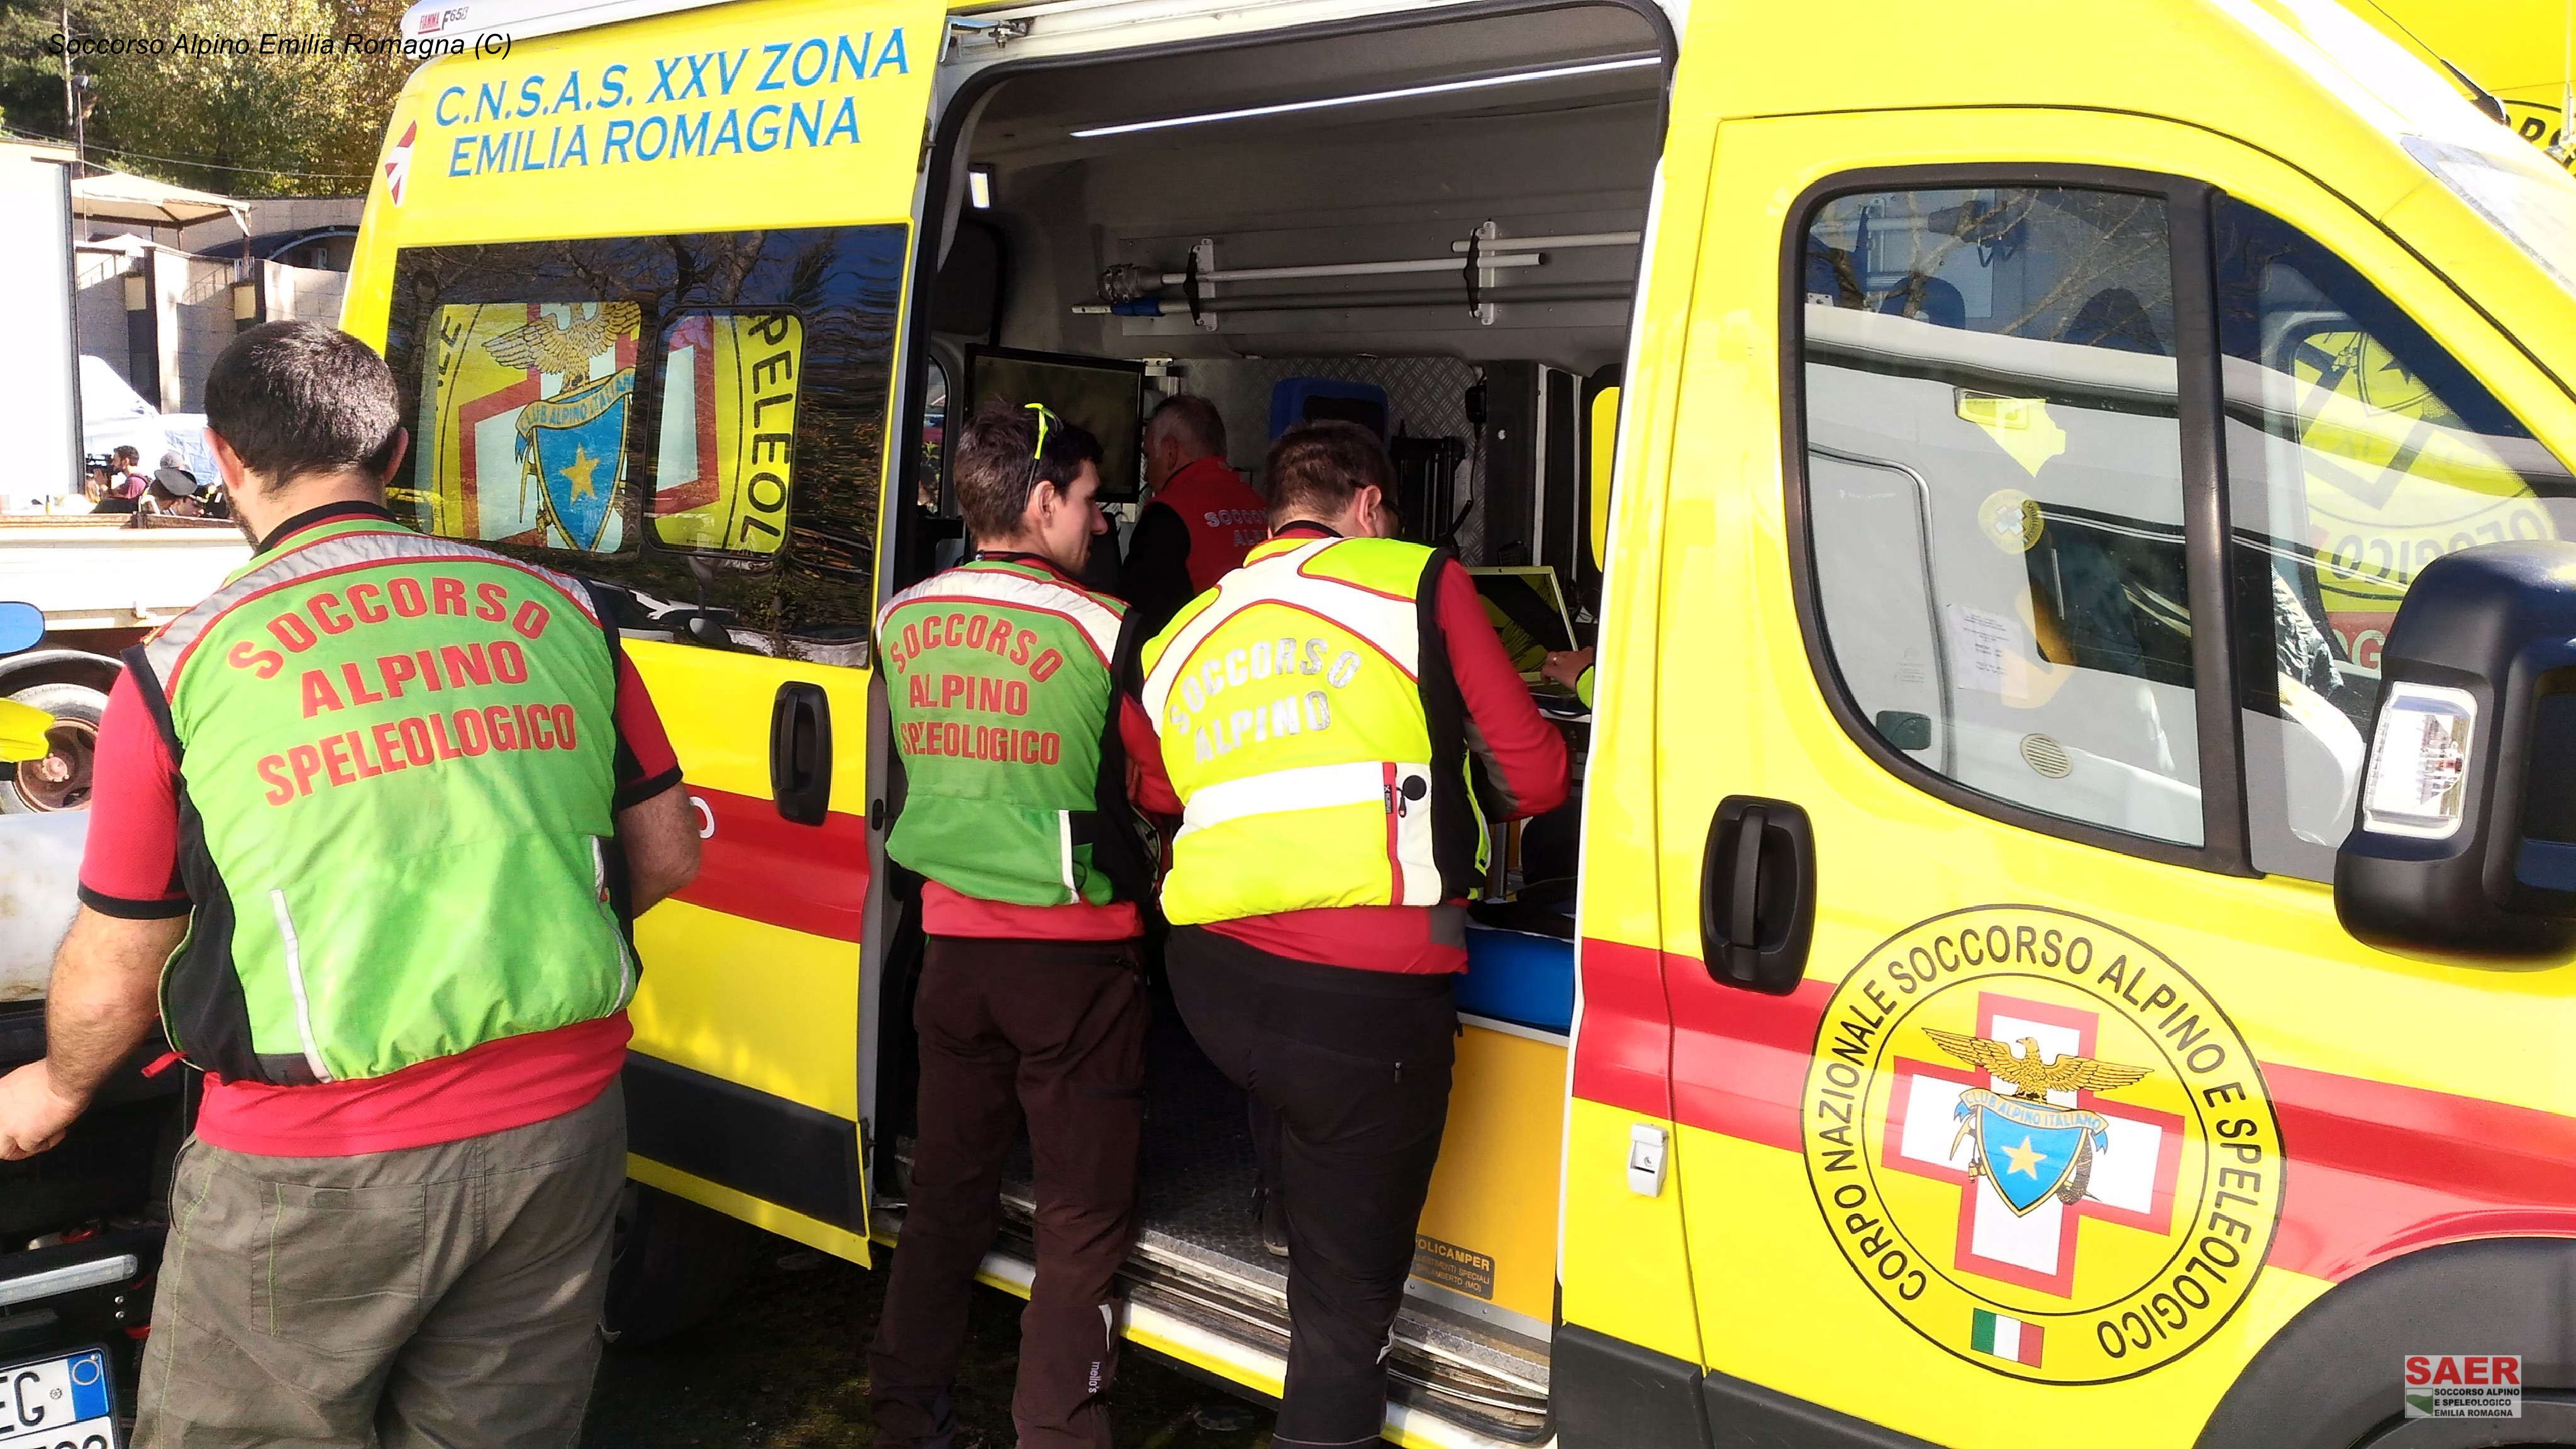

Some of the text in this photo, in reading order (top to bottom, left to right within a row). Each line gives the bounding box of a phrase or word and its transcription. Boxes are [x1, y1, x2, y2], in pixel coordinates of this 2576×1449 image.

[436, 27, 909, 127] C.N.S.A.S. XXV ZONA
[448, 96, 862, 177] EMILIA ROMAGNA
[520, 405, 547, 431] CLUB
[550, 402, 587, 426] ALPINO
[228, 577, 550, 680] SOCCORSO
[890, 613, 1063, 682] SOCCORSO
[301, 640, 528, 719] ALPINO
[909, 674, 1028, 716] ALPINO
[1169, 637, 1361, 735] SOCCORSO
[257, 703, 578, 807] SPELEOLOGICO
[1195, 691, 1331, 765] ALPINO
[1819, 924, 2262, 1359] CORPO NAZIONALE SOCCORSO ALPINO E SPELEOLOGICO
[1965, 1091, 2102, 1130] CLUB ALPINO ITALIANO
[1416, 1238, 1490, 1272] OLICAMPER
[1459, 1268, 1490, 1285] SPECIALI
[1465, 1280, 1482, 1292] (MO)
[1088, 1362, 1102, 1393] mello's
